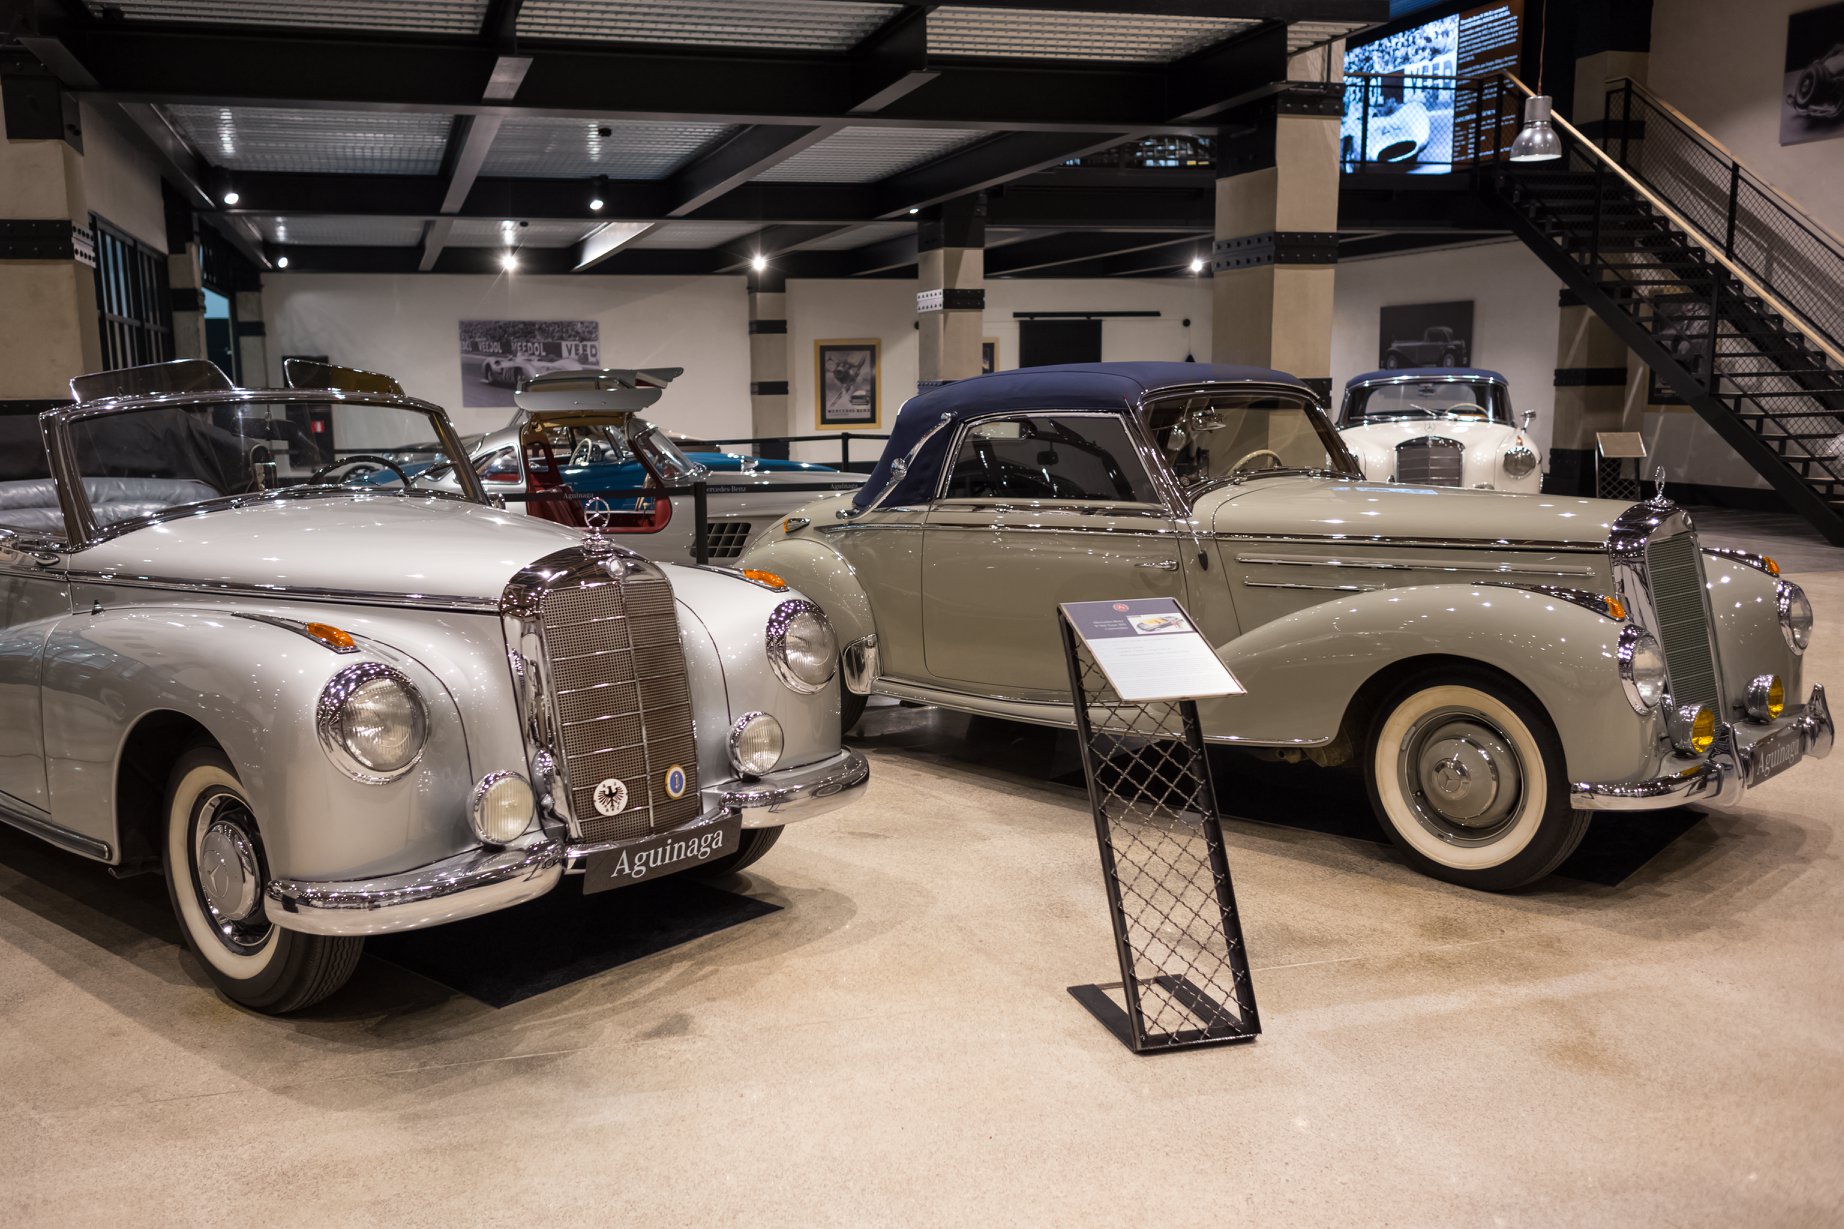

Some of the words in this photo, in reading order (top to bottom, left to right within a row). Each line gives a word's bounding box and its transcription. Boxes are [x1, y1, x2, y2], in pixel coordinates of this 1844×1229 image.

[565, 343, 598, 358] VEED
[1757, 739, 1799, 777] Aguinaga
[610, 829, 723, 879] Aguinaga
